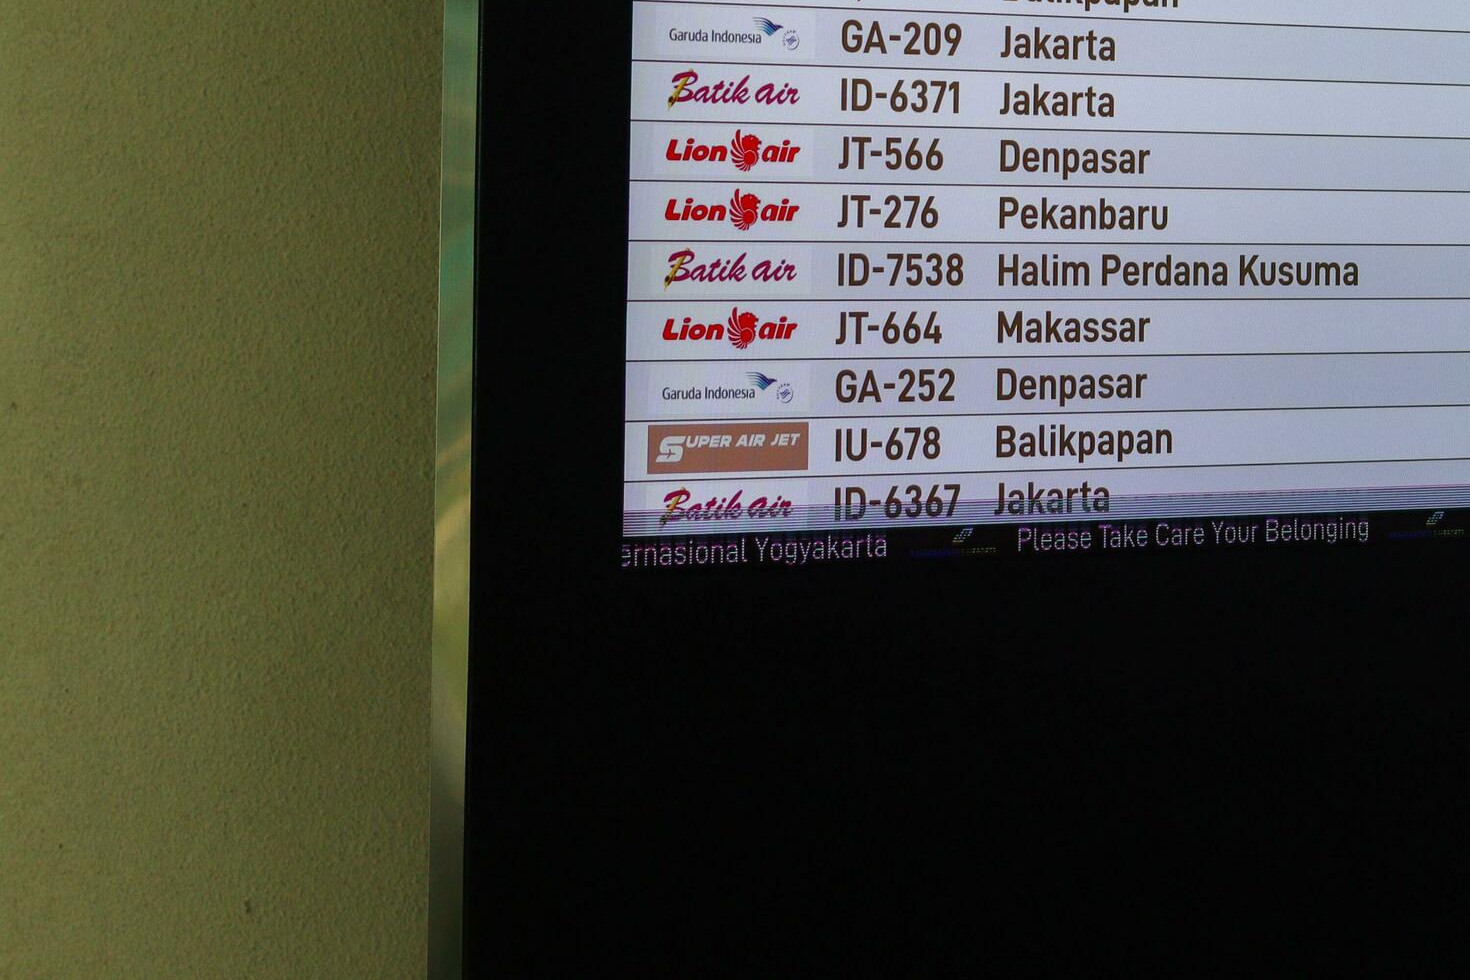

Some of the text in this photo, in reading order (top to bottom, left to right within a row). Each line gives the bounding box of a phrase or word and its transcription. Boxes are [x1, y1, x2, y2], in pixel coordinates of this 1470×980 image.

[669, 28, 708, 45] Garuda
[711, 29, 762, 45] Indonesia
[841, 19, 962, 57] GA-209
[1000, 25, 1116, 62] Jakarta
[668, 68, 751, 110] Batik
[754, 82, 801, 106] air
[840, 77, 960, 114] ID-6371
[999, 82, 1115, 118] Jakarta
[666, 138, 728, 162] Lion
[762, 139, 801, 163] air
[838, 136, 944, 171] JT-566
[999, 139, 1151, 181] Denpasar
[664, 198, 727, 221] Lion
[760, 198, 800, 222] air
[837, 194, 939, 229] JT-276
[998, 196, 1168, 231] Pekanbaru
[664, 248, 747, 291] Batik
[751, 259, 798, 282] air
[837, 252, 964, 287] ID-7538
[998, 253, 1090, 287] Halim
[1101, 253, 1228, 287] Perdana
[1239, 254, 1359, 287] Kusuma
[662, 317, 725, 341] Lion
[758, 316, 798, 340] air
[835, 311, 943, 345] JT-664
[997, 310, 1151, 344] Makassar
[662, 386, 701, 400] Garuda
[704, 386, 756, 400] Indonesia
[835, 368, 956, 404] GA-252
[996, 367, 1148, 408] Denpasar
[655, 434, 733, 463] SUPER
[735, 433, 766, 448] AIR
[770, 432, 801, 447] JET
[834, 426, 941, 462] IU-678
[996, 424, 1173, 464] Balikpapan
[659, 487, 743, 530] Batik
[747, 495, 792, 519] air
[834, 483, 962, 521] ID-6367
[994, 480, 1111, 515] Jakarta
[755, 534, 888, 565] Yogyakarta
[1017, 525, 1092, 551] Please
[1099, 523, 1148, 549] Take
[1155, 520, 1205, 546] Care
[1212, 520, 1258, 544] Your
[1265, 517, 1369, 542] Belonging
